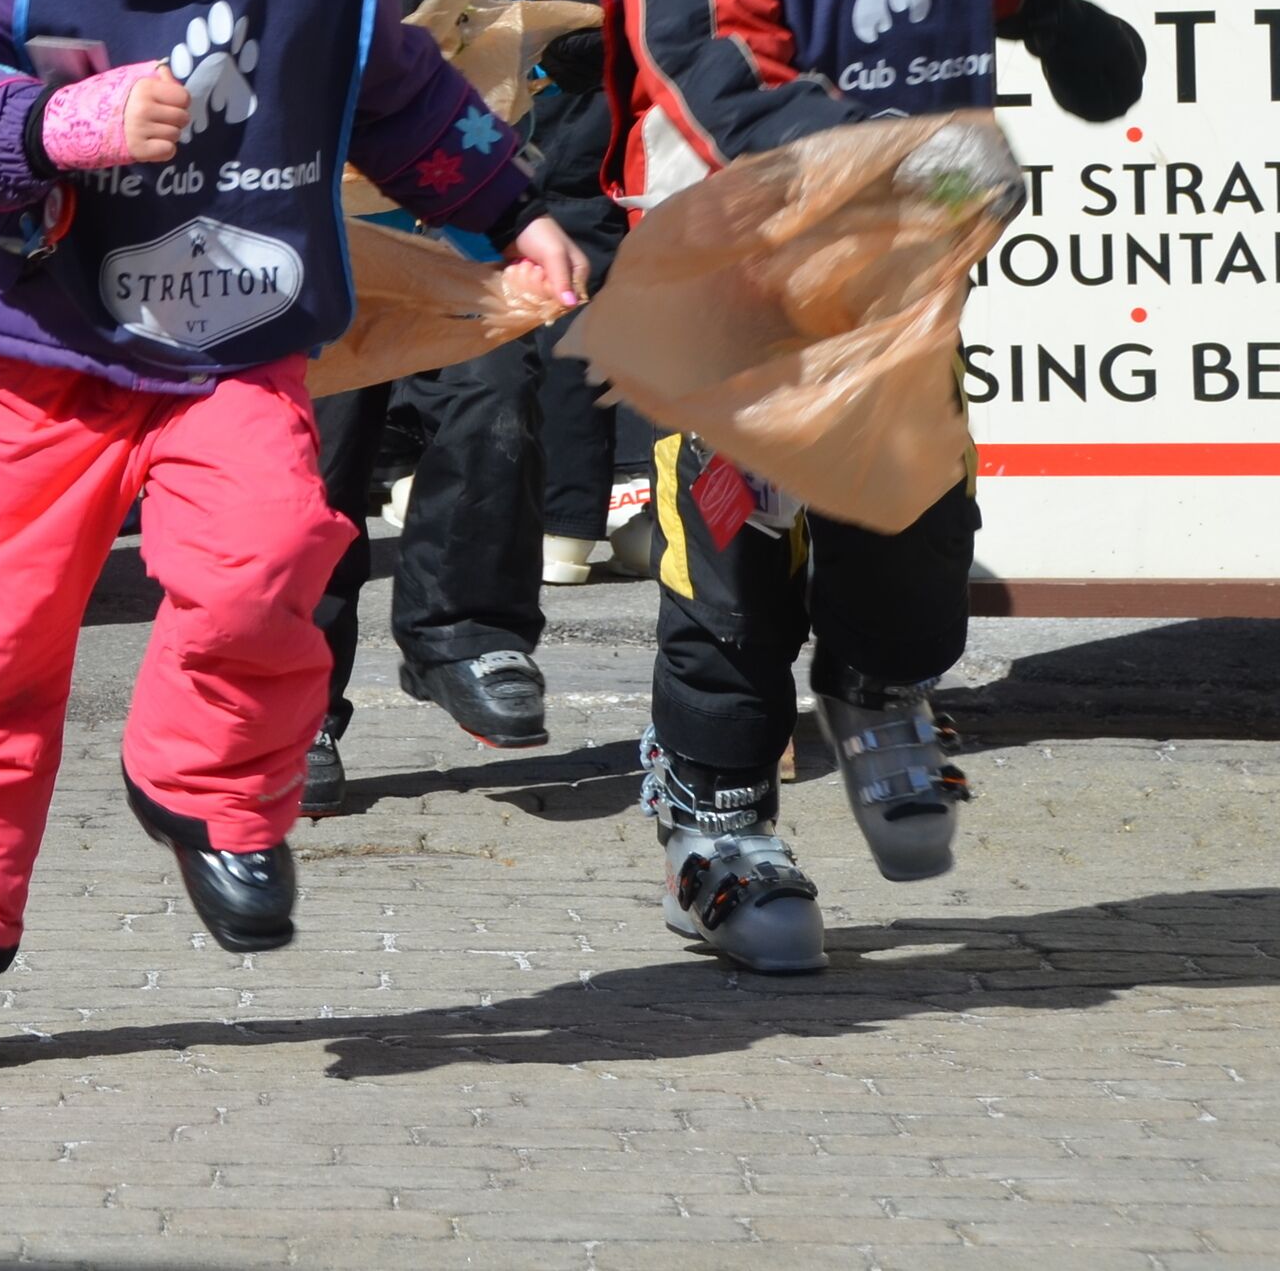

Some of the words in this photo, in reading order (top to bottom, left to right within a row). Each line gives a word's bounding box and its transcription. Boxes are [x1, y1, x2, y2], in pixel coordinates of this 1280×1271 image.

[838, 58, 897, 92] Cub
[155, 160, 204, 196] Cub
[115, 266, 279, 308] STRATTON
[185, 319, 209, 334] VT
[965, 342, 1158, 403] SING
